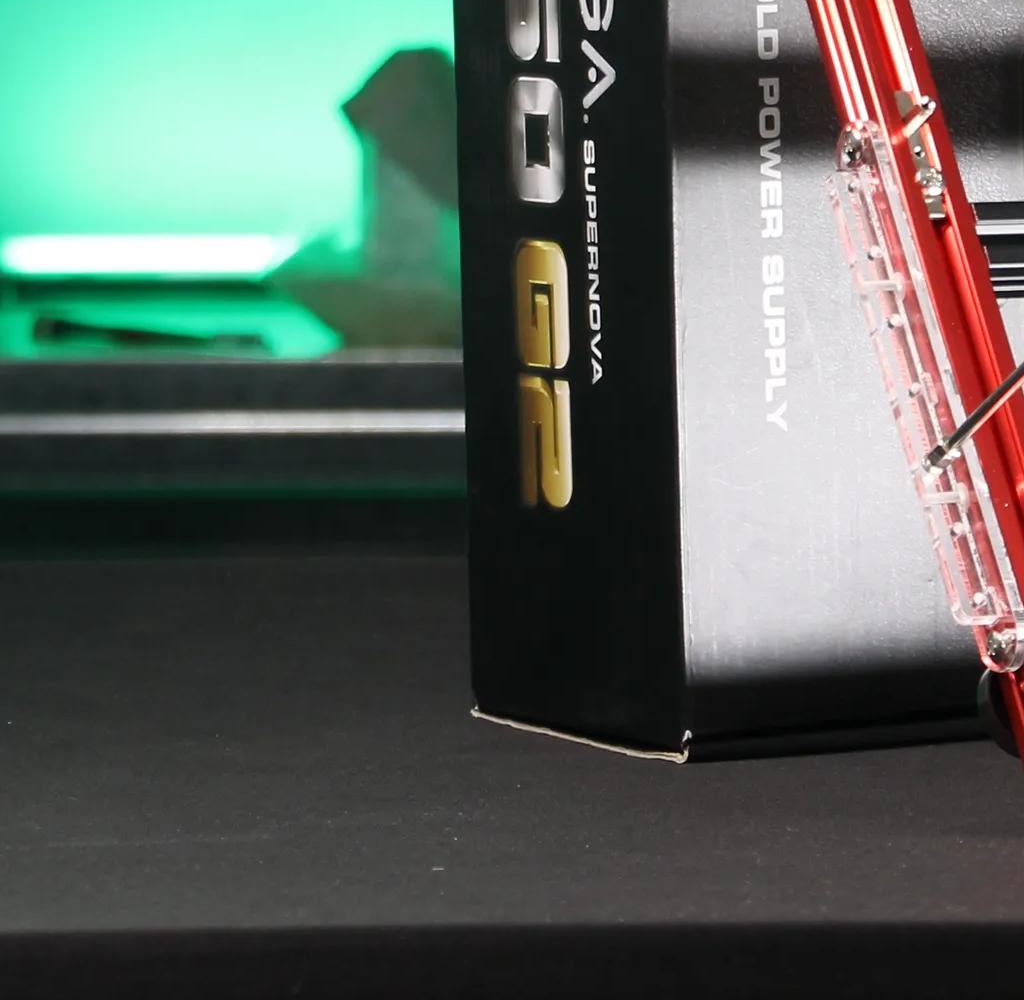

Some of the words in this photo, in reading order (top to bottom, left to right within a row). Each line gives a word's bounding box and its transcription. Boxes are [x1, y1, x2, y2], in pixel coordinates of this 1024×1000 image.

[582, 139, 603, 386] SUPERNOVA
[757, 77, 783, 239] POWER
[514, 238, 574, 509] G2
[761, 253, 789, 433] SUPPLY
